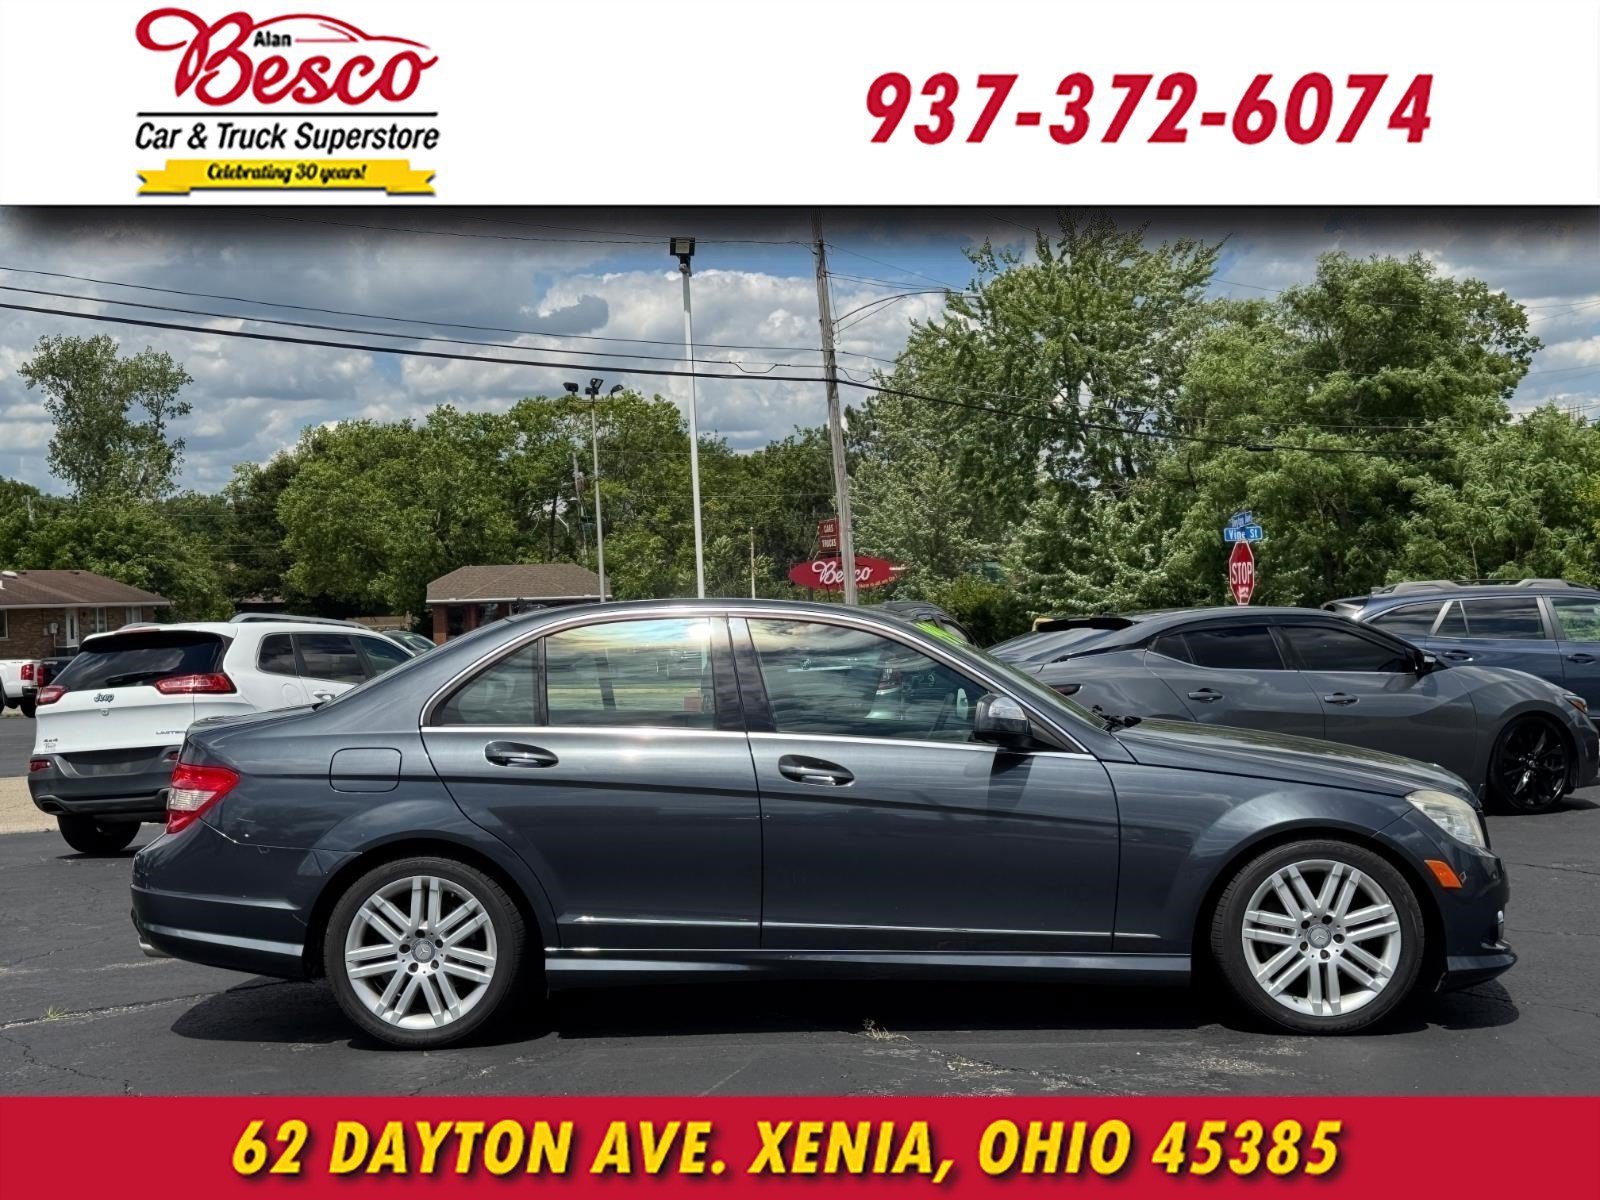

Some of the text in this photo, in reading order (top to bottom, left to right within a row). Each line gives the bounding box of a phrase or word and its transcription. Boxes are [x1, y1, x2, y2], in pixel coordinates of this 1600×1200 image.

[1228, 528, 1258, 540] Vine St
[812, 561, 873, 584] Beco
[1232, 562, 1252, 584] STOP
[94, 693, 114, 702] Jeep
